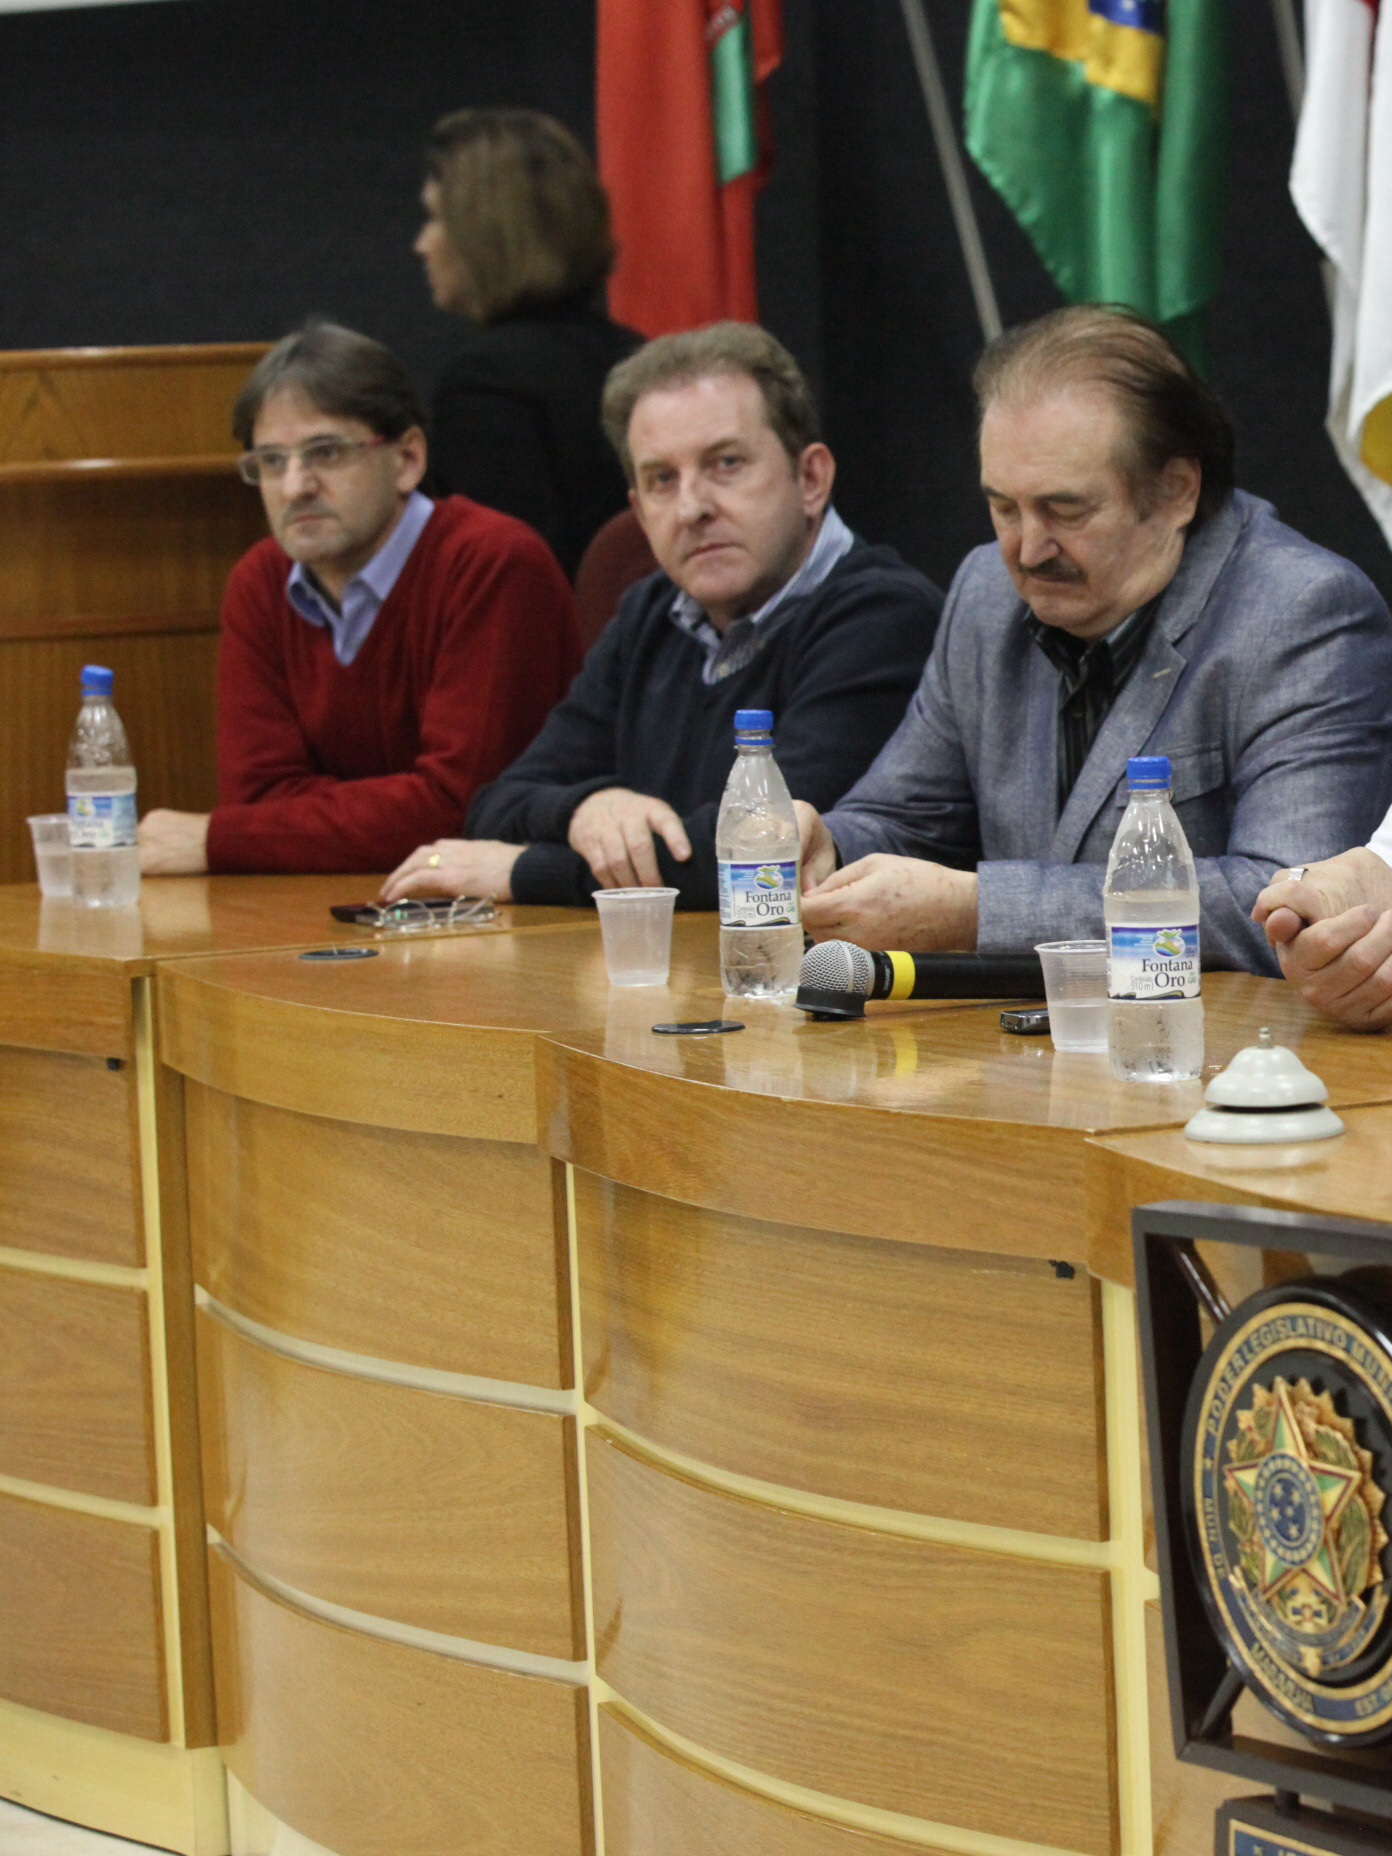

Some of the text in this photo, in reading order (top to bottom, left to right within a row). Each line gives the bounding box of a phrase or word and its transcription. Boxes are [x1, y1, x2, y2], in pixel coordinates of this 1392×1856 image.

[745, 891, 792, 903] Fontana
[756, 902, 784, 916] Oro
[1142, 959, 1193, 973] Fontana
[1155, 972, 1185, 988] Oro
[1207, 1350, 1246, 1433] PODER
[1242, 1316, 1349, 1357] LEGISLATIVO
